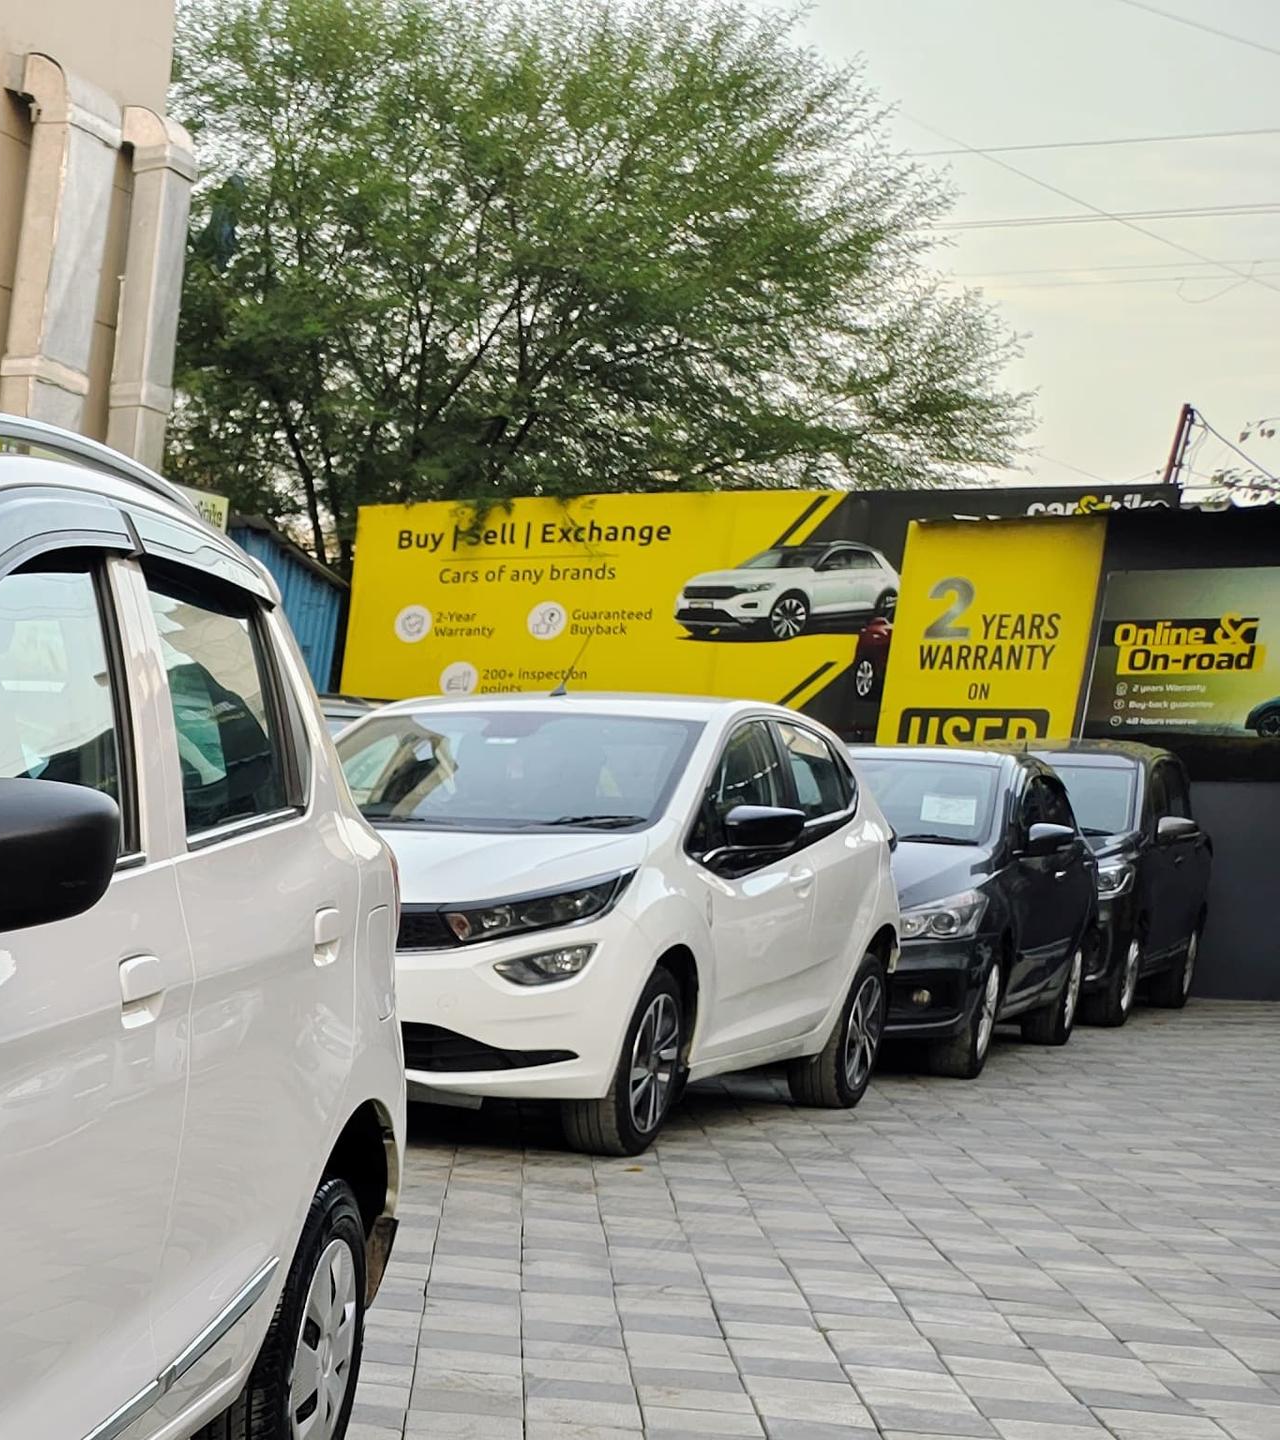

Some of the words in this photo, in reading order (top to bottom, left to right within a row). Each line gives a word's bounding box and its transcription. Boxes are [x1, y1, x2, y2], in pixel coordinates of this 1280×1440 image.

[398, 530, 445, 553] Buy
[465, 523, 515, 546] Sell
[541, 519, 671, 547] Exchange
[439, 568, 479, 584] Cars
[485, 565, 506, 582] of
[510, 569, 544, 585] any
[550, 562, 616, 581] brands
[436, 611, 476, 624] 2-Year
[572, 608, 653, 622] Guaranteed
[922, 576, 975, 640] 2
[982, 613, 1062, 640] YEARS
[434, 625, 495, 638] Warranty
[570, 622, 627, 636] Buyback
[1114, 621, 1206, 647] Online
[1213, 611, 1259, 645] &
[919, 645, 1055, 670] WARRANTY
[1128, 645, 1256, 671] On-road
[482, 669, 514, 680] 200+
[518, 668, 587, 682] inspection
[968, 682, 990, 700] ON
